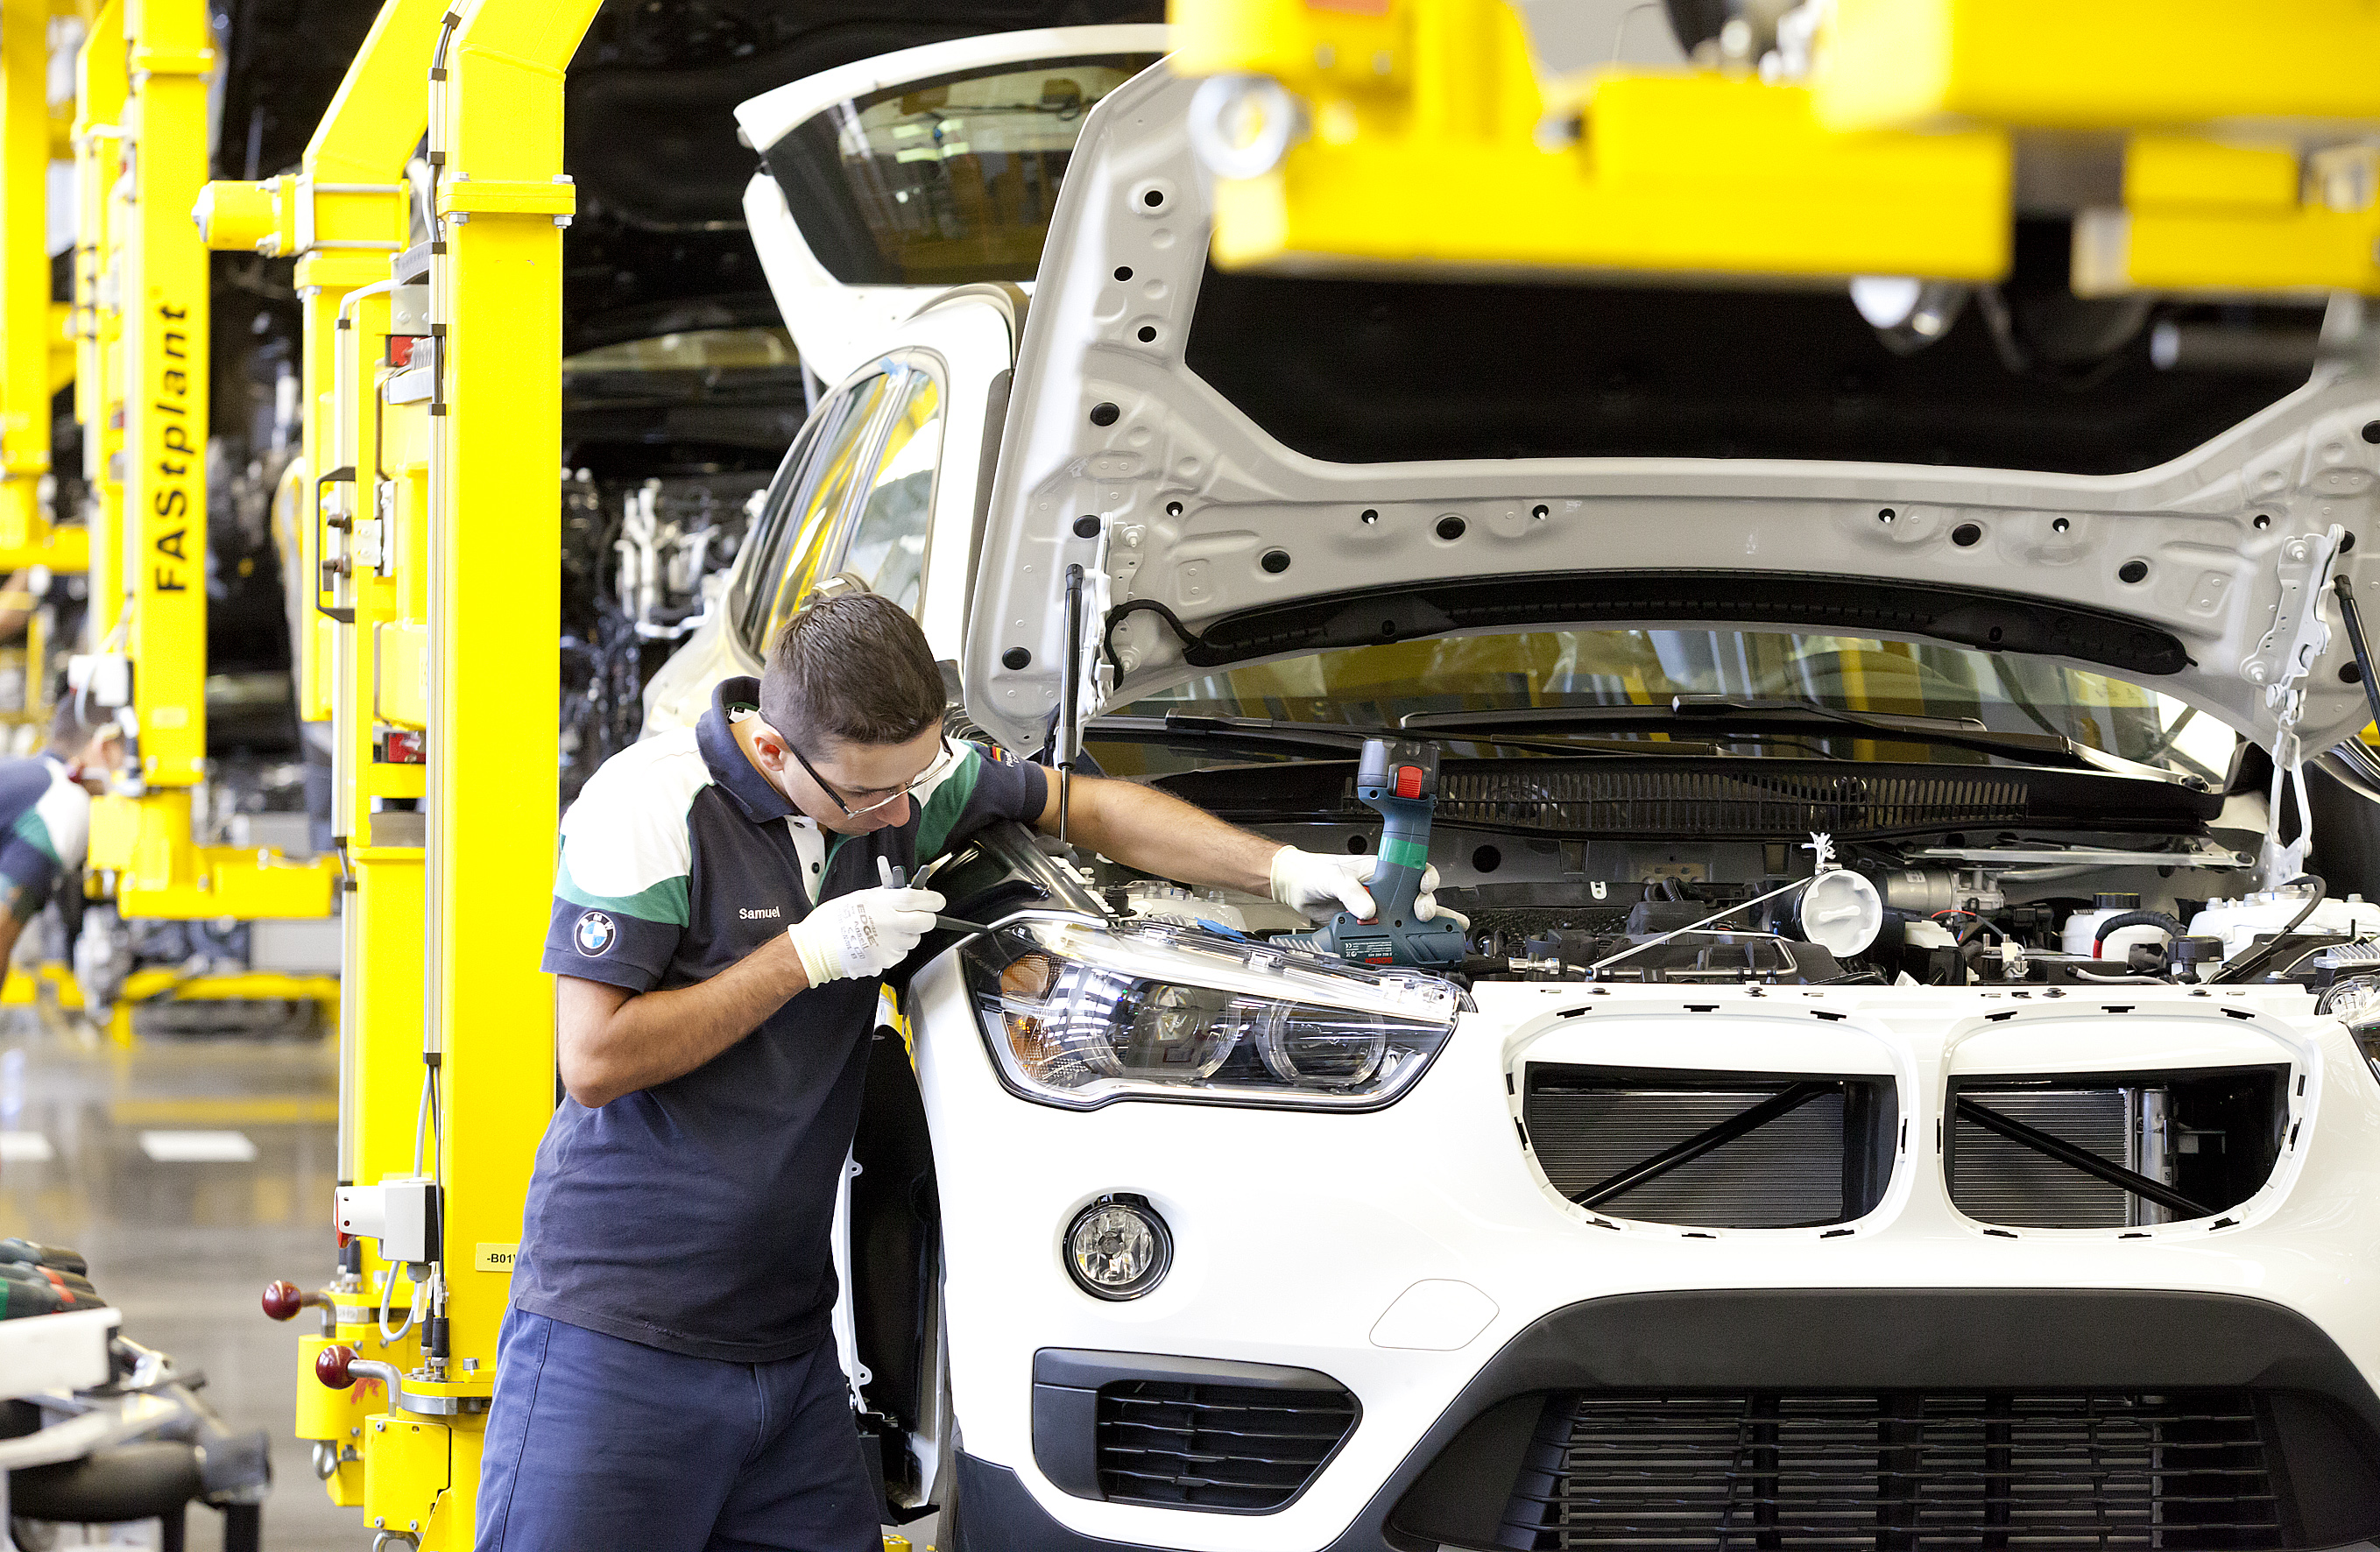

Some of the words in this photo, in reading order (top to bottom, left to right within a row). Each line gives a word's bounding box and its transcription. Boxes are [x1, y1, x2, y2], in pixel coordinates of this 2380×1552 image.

[155, 305, 194, 592] FAStplant
[738, 906, 780, 920] Samuel
[857, 904, 875, 946] EDGE
